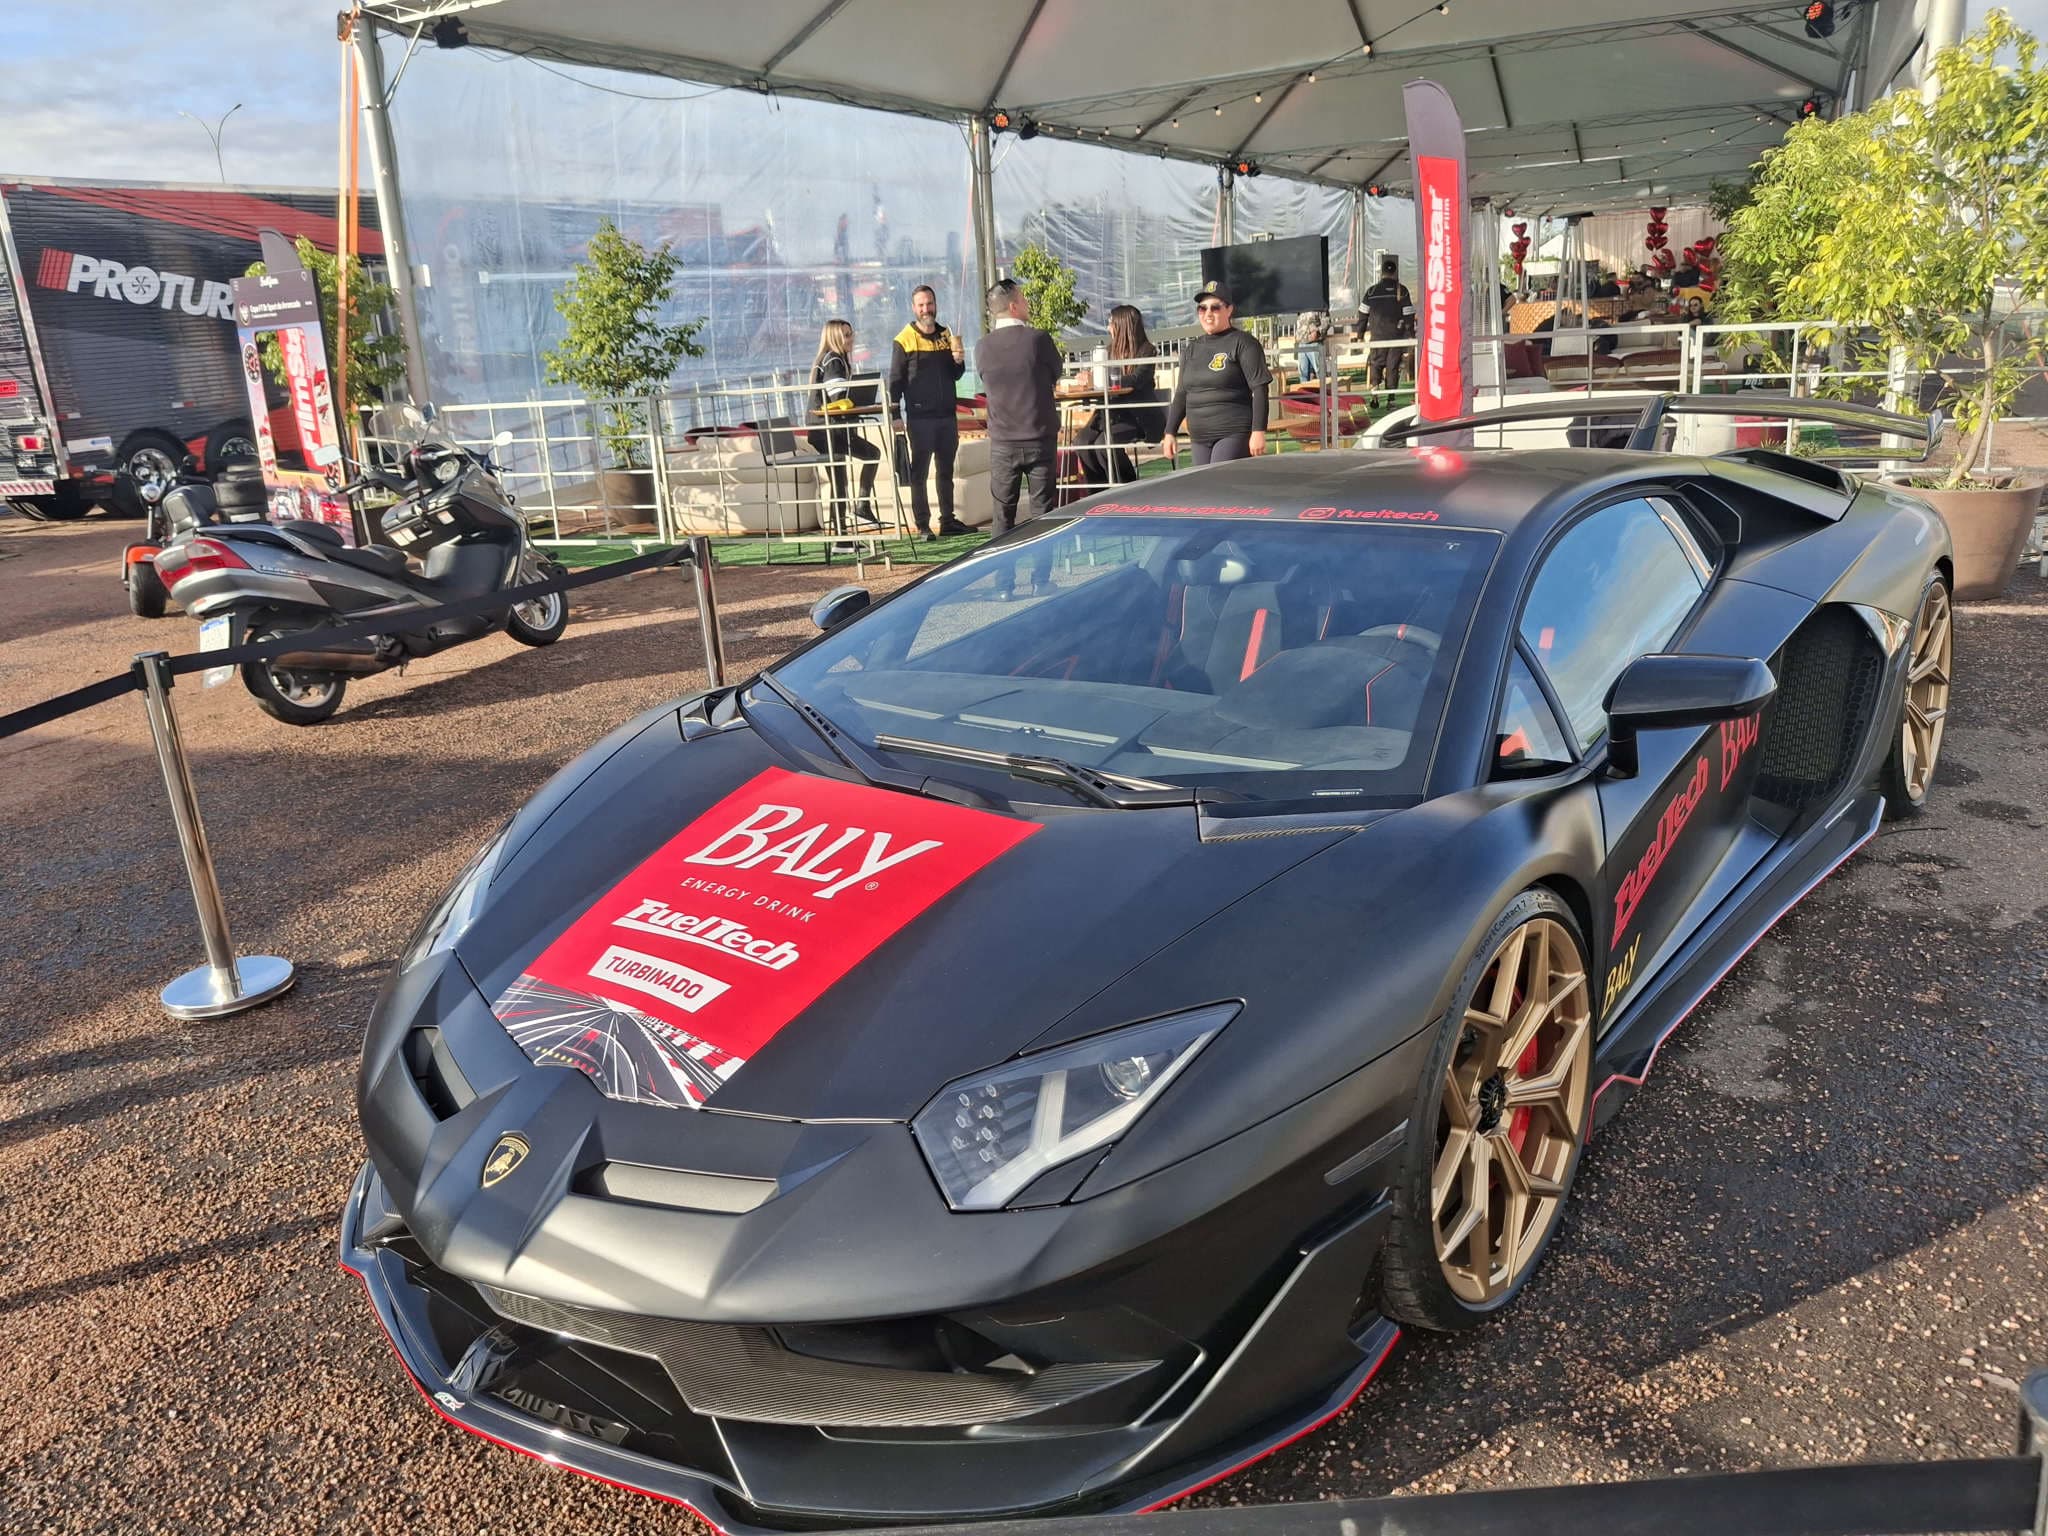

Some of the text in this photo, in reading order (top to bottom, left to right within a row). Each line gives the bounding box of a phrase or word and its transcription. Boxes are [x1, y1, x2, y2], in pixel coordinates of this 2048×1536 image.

[1428, 185, 1446, 399] FilmStar
[1336, 508, 1440, 521] fueltech
[683, 804, 944, 899] BALY
[1611, 755, 1709, 951] FuelTech
[620, 898, 800, 970] FuelTech
[680, 877, 816, 923] ENERGY DRINK
[1475, 904, 1521, 960] SportContact
[605, 955, 704, 999] TURBINADO
[1601, 933, 1641, 1020] BALY
